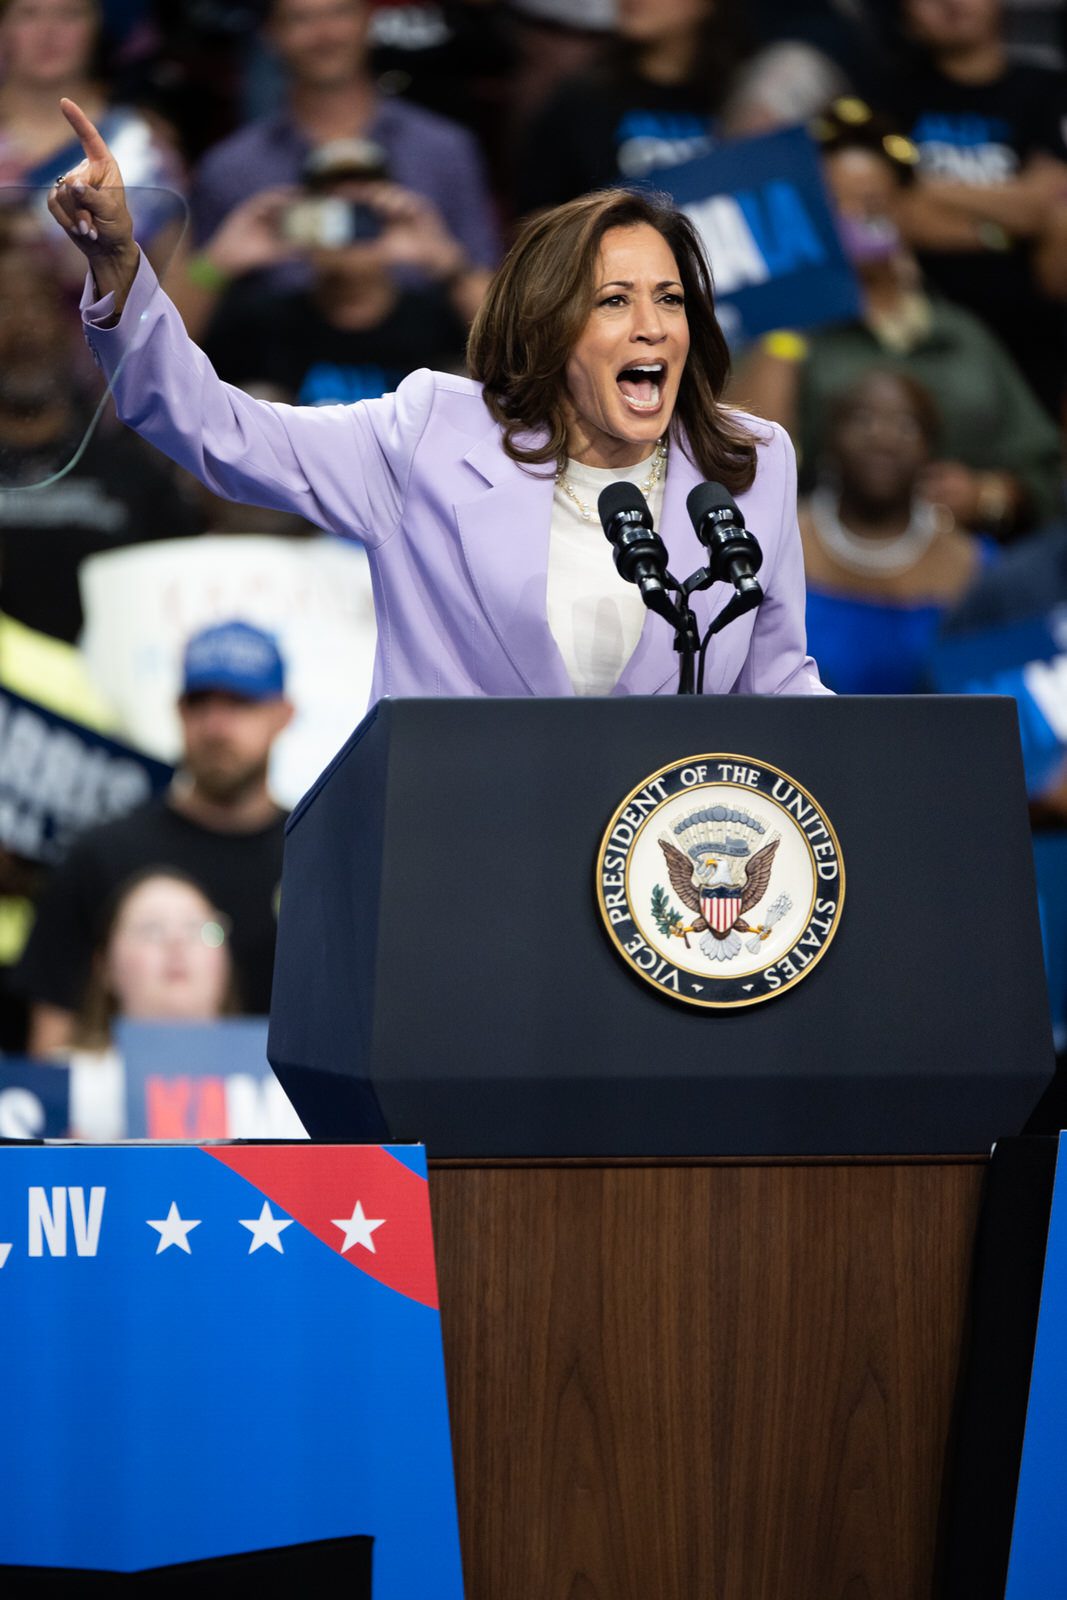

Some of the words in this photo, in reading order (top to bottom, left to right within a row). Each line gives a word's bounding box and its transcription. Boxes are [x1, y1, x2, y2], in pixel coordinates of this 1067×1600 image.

[680, 764, 708, 787] OF
[717, 764, 761, 788] THE
[602, 776, 670, 926] PRESIDENT
[771, 778, 839, 881] UNITED
[623, 932, 682, 992] VICE
[763, 897, 837, 990] STATES
[28, 1186, 107, 1257] NV
